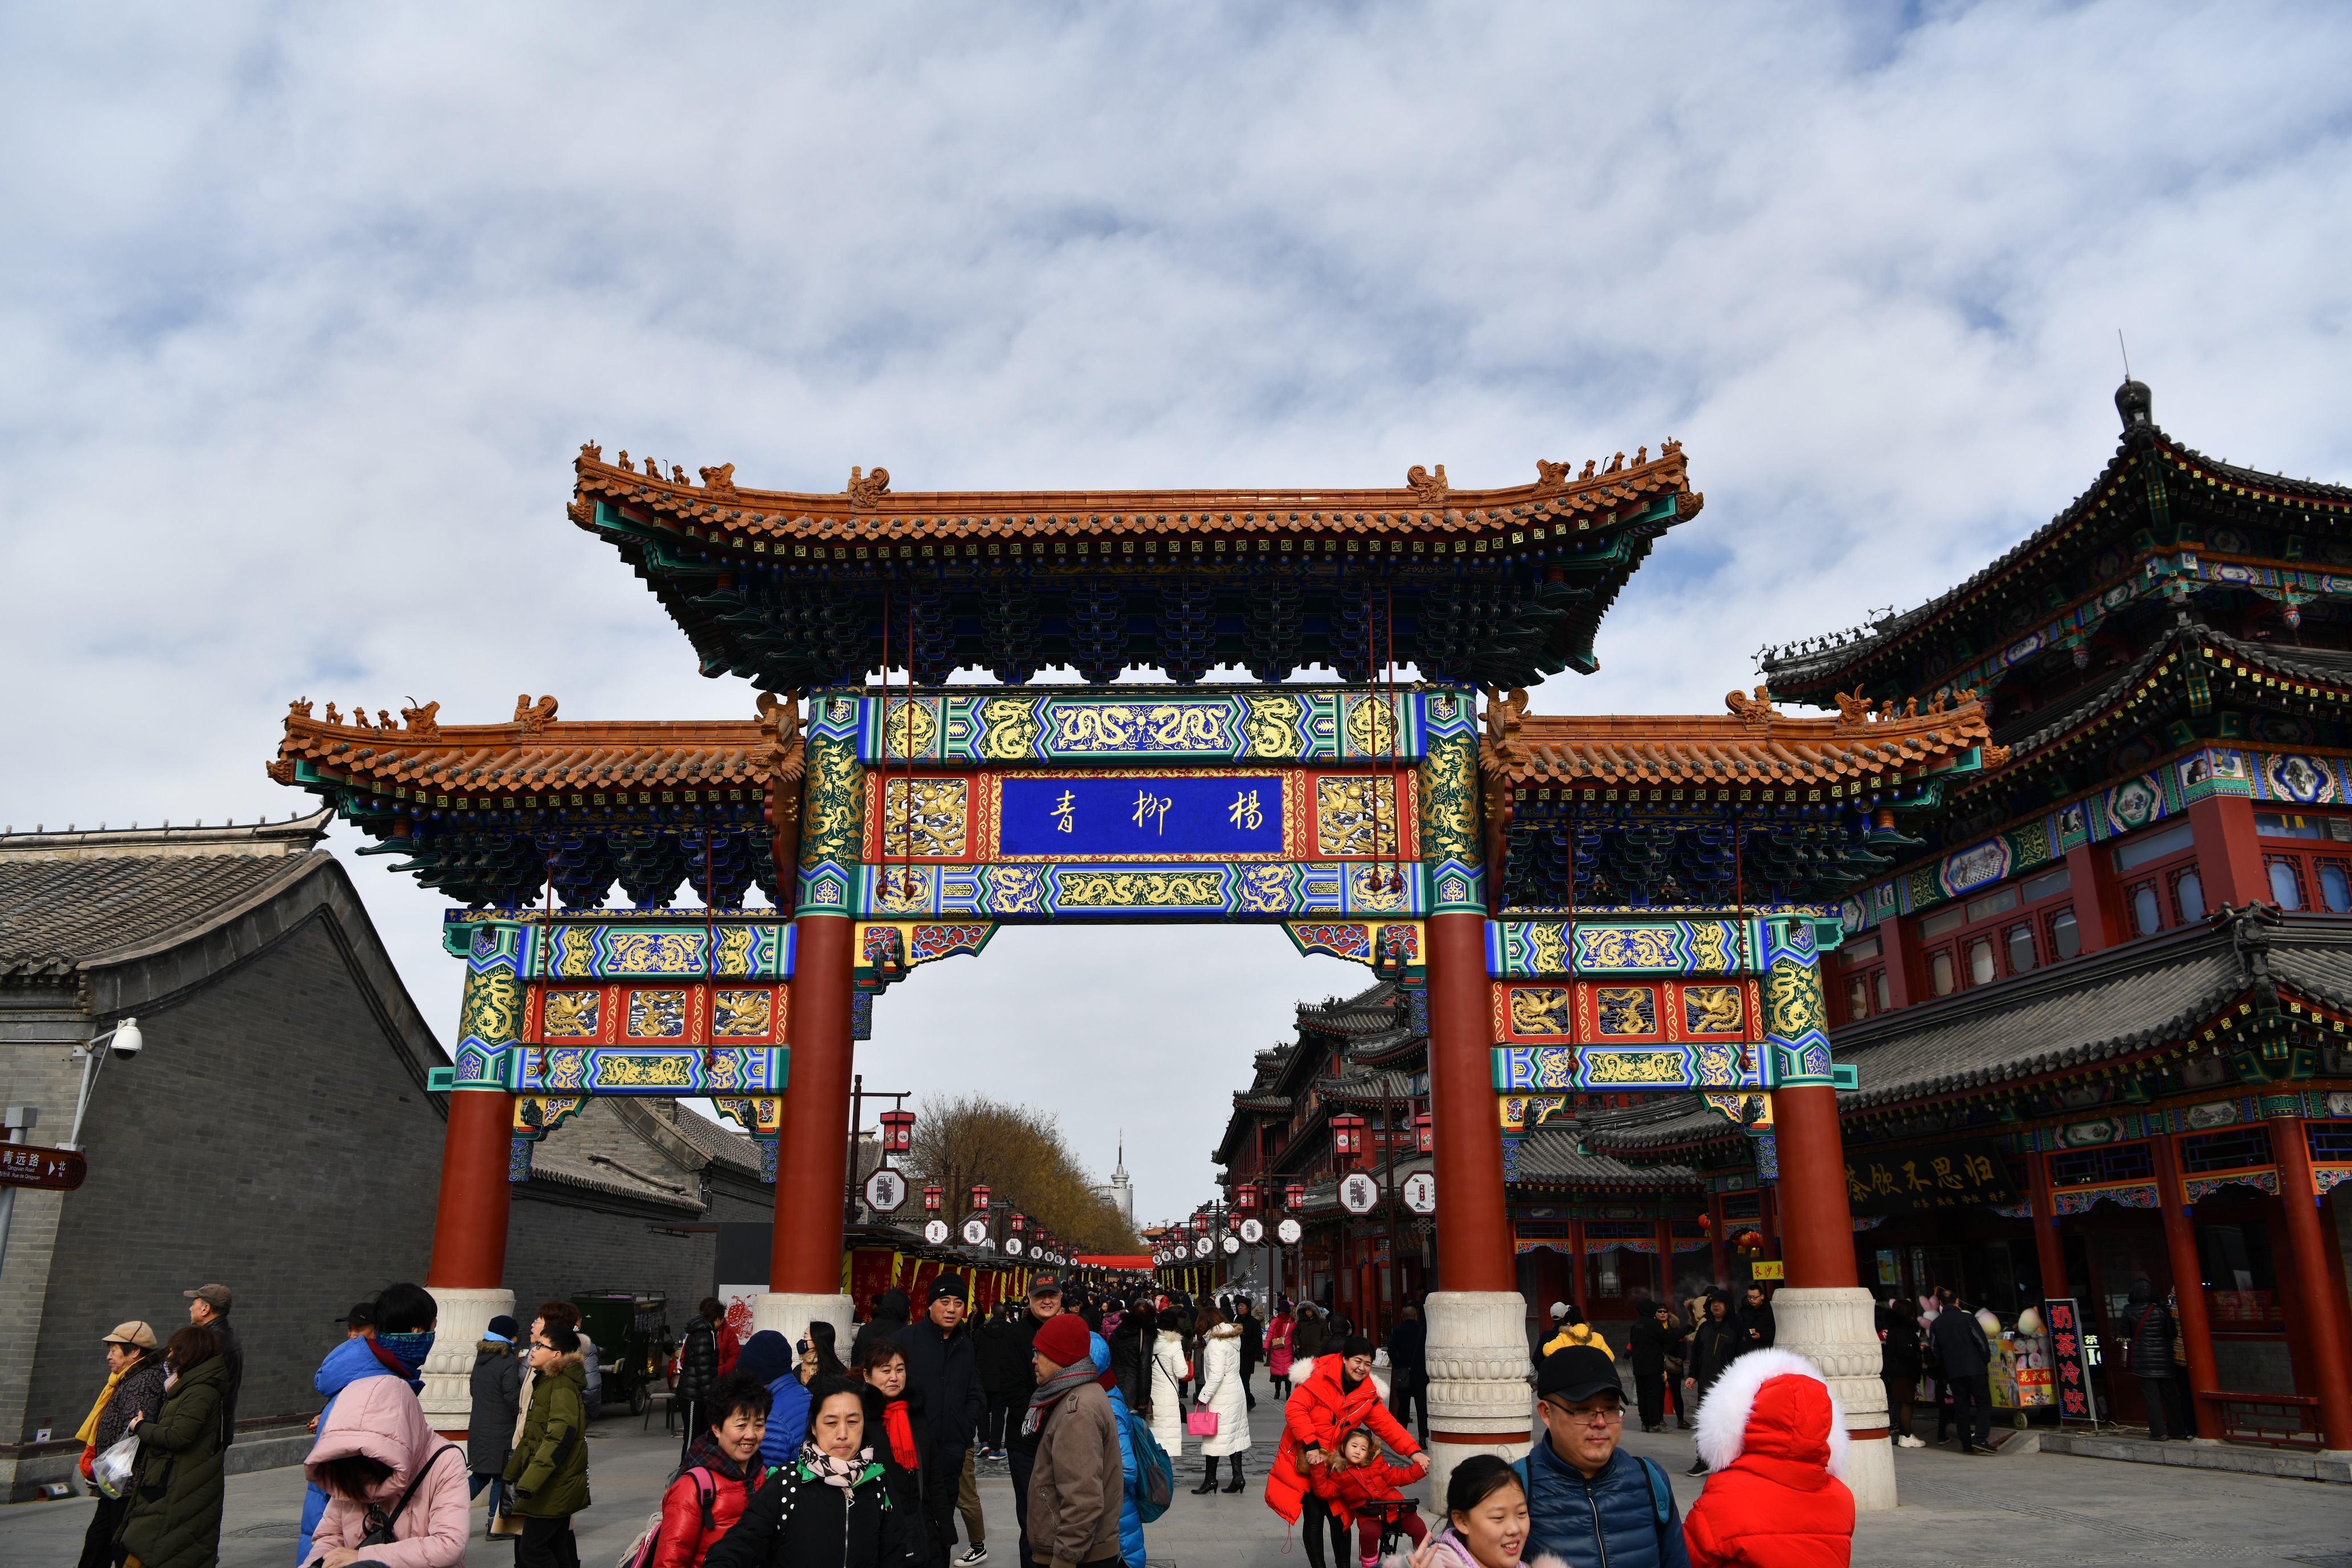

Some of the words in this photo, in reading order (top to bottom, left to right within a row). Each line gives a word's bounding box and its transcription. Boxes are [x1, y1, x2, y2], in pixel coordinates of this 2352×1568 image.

[3, 1150, 39, 1167] 青远路
[58, 1161, 66, 1171] 北
[859, 1257, 885, 1267] 正宗
[916, 1279, 928, 1317] 棉花糖
[2051, 1305, 2086, 1414] 奶茶冷饮
